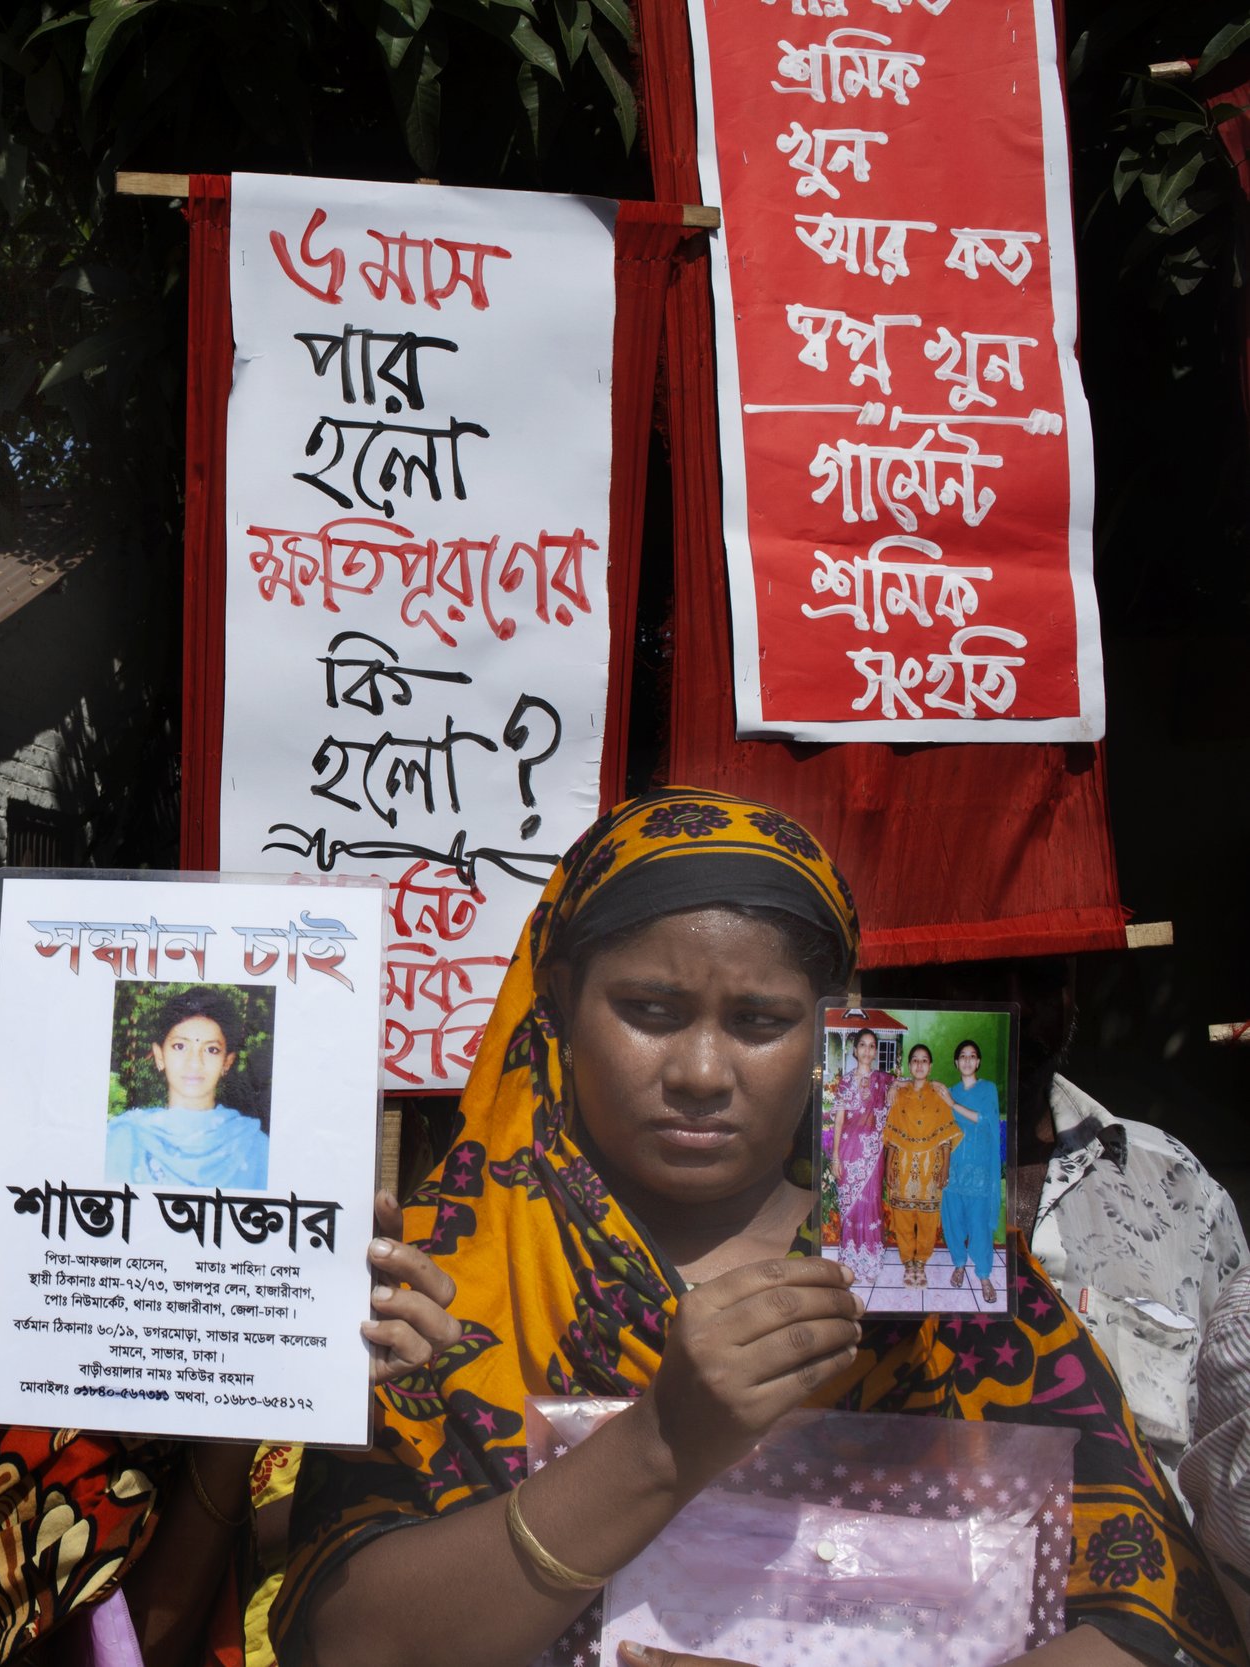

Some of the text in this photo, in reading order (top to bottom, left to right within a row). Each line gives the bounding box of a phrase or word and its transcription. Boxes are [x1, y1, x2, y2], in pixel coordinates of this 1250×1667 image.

[771, 27, 926, 106] শ্রমিক
[776, 121, 889, 200] খুন
[359, 230, 513, 311] মাস
[794, 211, 1042, 287] আর কত
[293, 323, 459, 413] পার
[785, 303, 1039, 411] স্বপ্ন খুন
[292, 416, 490, 518] হলো
[246, 517, 600, 648] ক্ষতিপূরণের
[801, 534, 993, 634] শ্রমিক
[315, 631, 473, 716] কি
[846, 625, 1027, 719] সংহতি
[27, 910, 357, 992] সন্ধান চাই
[6, 1179, 343, 1254] শান্তা আক্তার
[28, 1271, 52, 1287] স্থায়ী
[55, 1271, 95, 1287] ঠিকানাঃ
[173, 1281, 220, 1296] ভাগলপুর
[44, 1294, 66, 1306] পোঃ
[126, 1258, 167, 1273] হোসেন,
[195, 1261, 226, 1273] মাতাঃ
[271, 1266, 300, 1277] বেগম
[13, 1318, 49, 1332] বর্তমান
[53, 1318, 92, 1334] ঠিকানাঃ
[206, 1330, 239, 1343] সাভার
[243, 1333, 275, 1344] মডেল
[279, 1335, 327, 1347] কলেজের
[109, 1345, 146, 1360] সামনে,
[151, 1348, 187, 1363] সাভার,
[20, 1381, 69, 1395] মোবাইলঃ
[174, 1391, 208, 1406] অথবা,
[147, 1368, 172, 1380] নামঃ
[176, 1367, 214, 1383] মতিউর
[219, 1373, 254, 1385] রহমান
